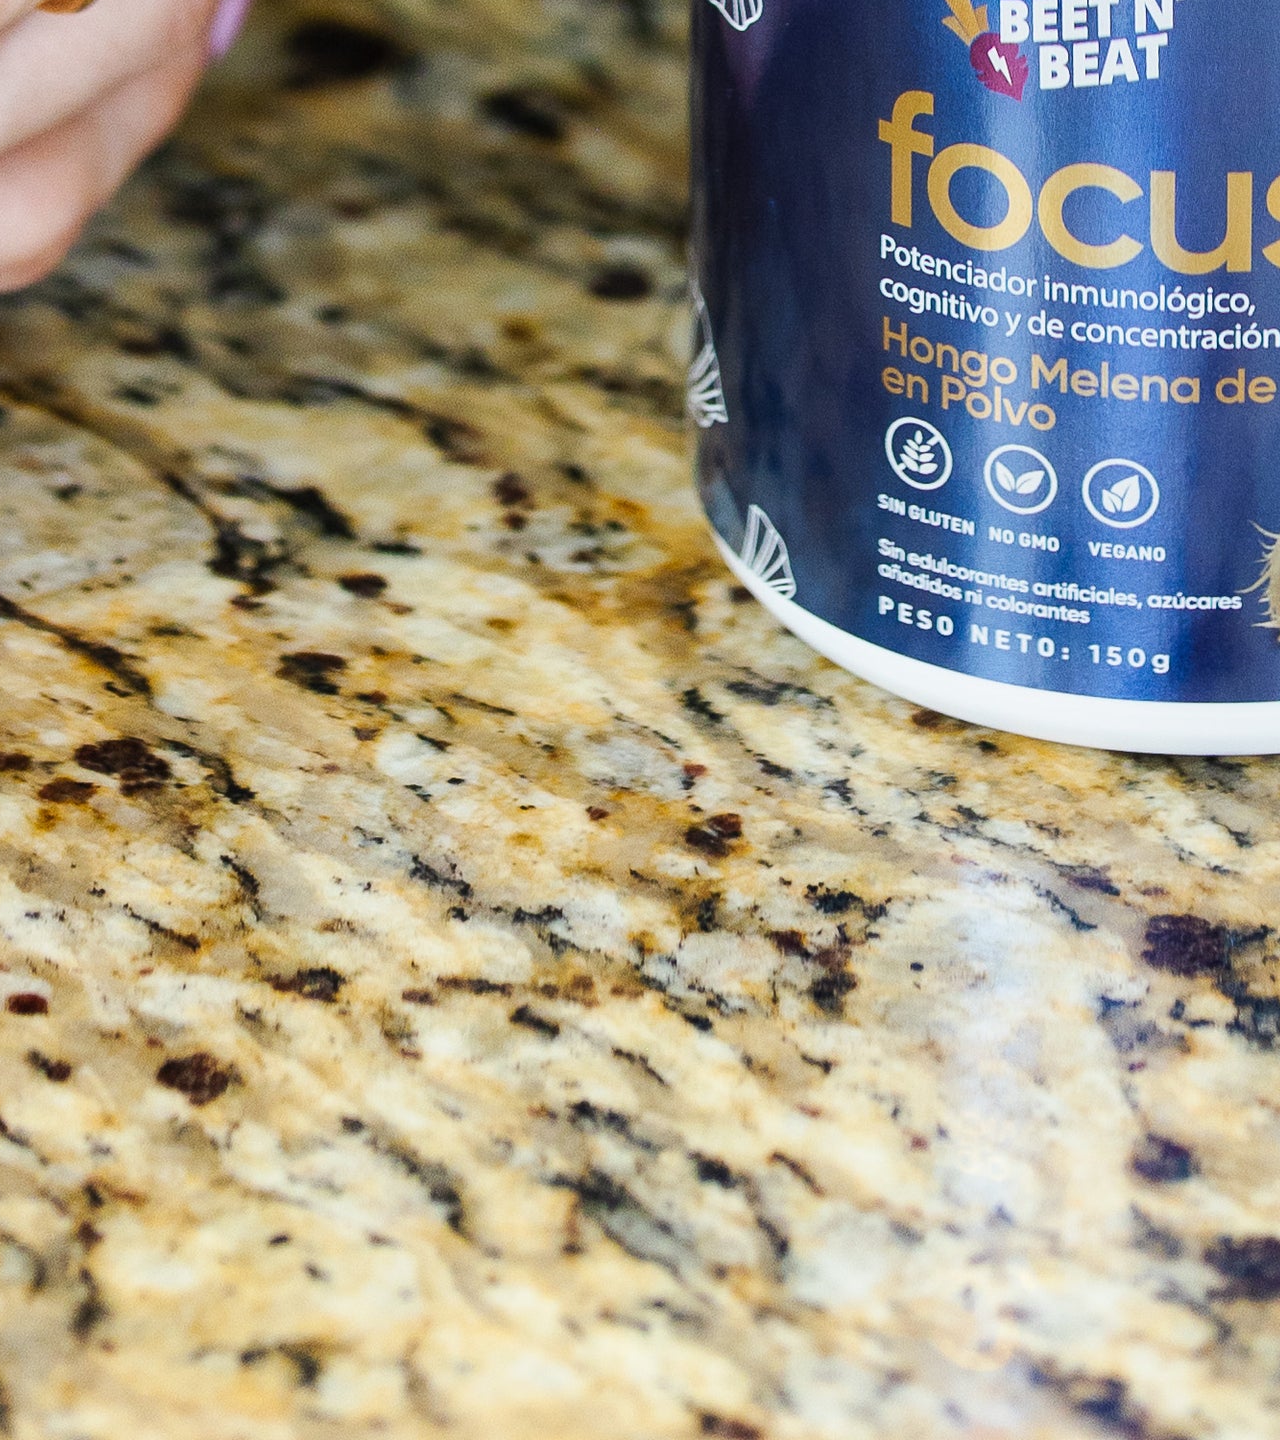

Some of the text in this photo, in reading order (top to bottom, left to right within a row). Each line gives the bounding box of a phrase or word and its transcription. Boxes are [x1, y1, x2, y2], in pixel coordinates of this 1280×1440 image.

[1039, 32, 1169, 90] BEAT
[880, 234, 1256, 320] Potenciador inmunológico,
[879, 278, 999, 328] cognitivo
[1005, 311, 1022, 337] y
[1027, 310, 1065, 339] de
[882, 316, 1018, 388] Hongo
[1031, 353, 1201, 404] Melena
[1215, 367, 1277, 404] de
[881, 366, 1057, 431] en Polvo
[877, 493, 975, 536] SIN GLUTEN
[988, 526, 1060, 552] NO GMO
[877, 538, 1243, 610] Sin edulcorantes artificiales, azúcares
[1088, 541, 1166, 562] VEGANO
[877, 563, 1091, 624] añadidos ni colorantes
[878, 595, 1170, 674] PESO NETO: 150g
